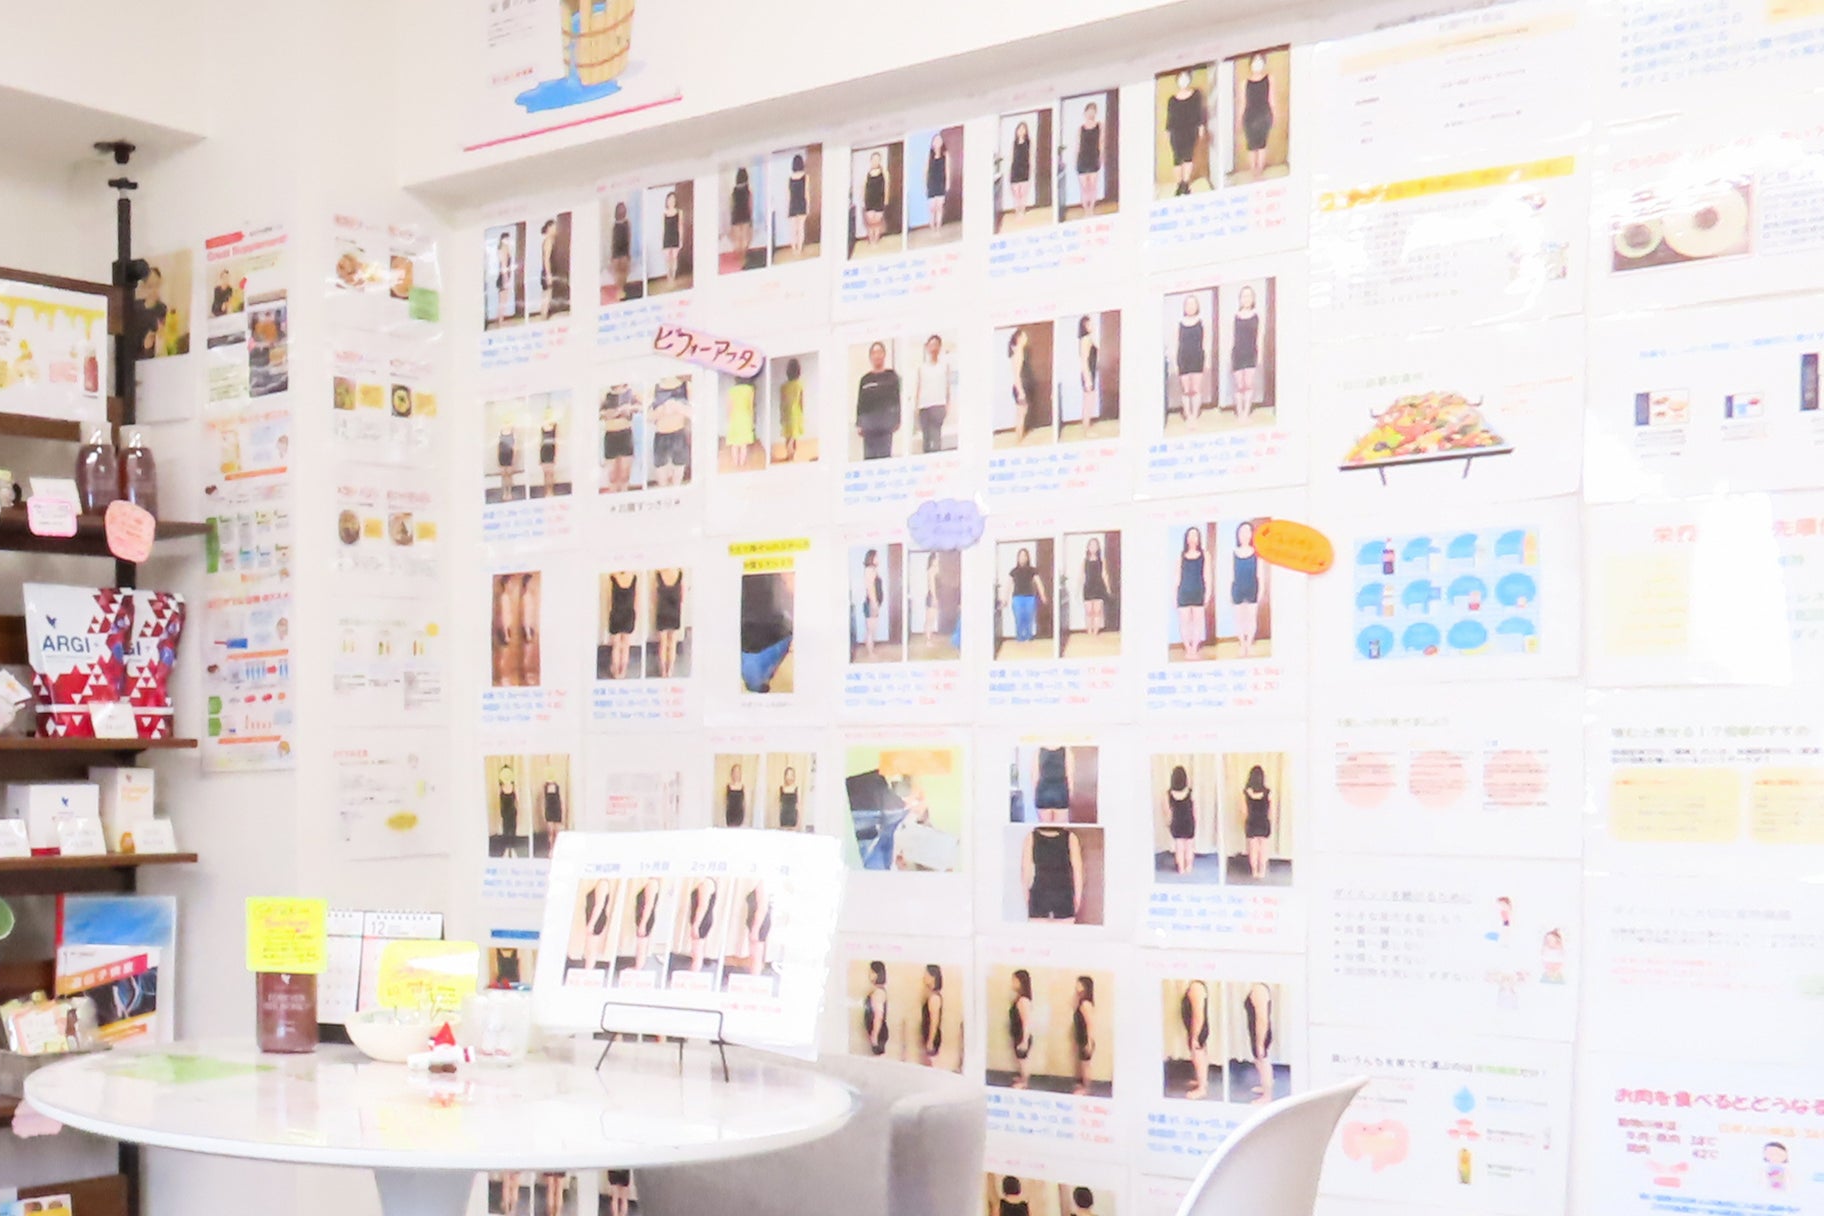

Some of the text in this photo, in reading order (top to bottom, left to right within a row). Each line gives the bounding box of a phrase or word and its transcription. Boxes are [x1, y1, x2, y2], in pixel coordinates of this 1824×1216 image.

[653, 325, 758, 371] ビフォーアフター
[371, 922, 386, 936] 12
